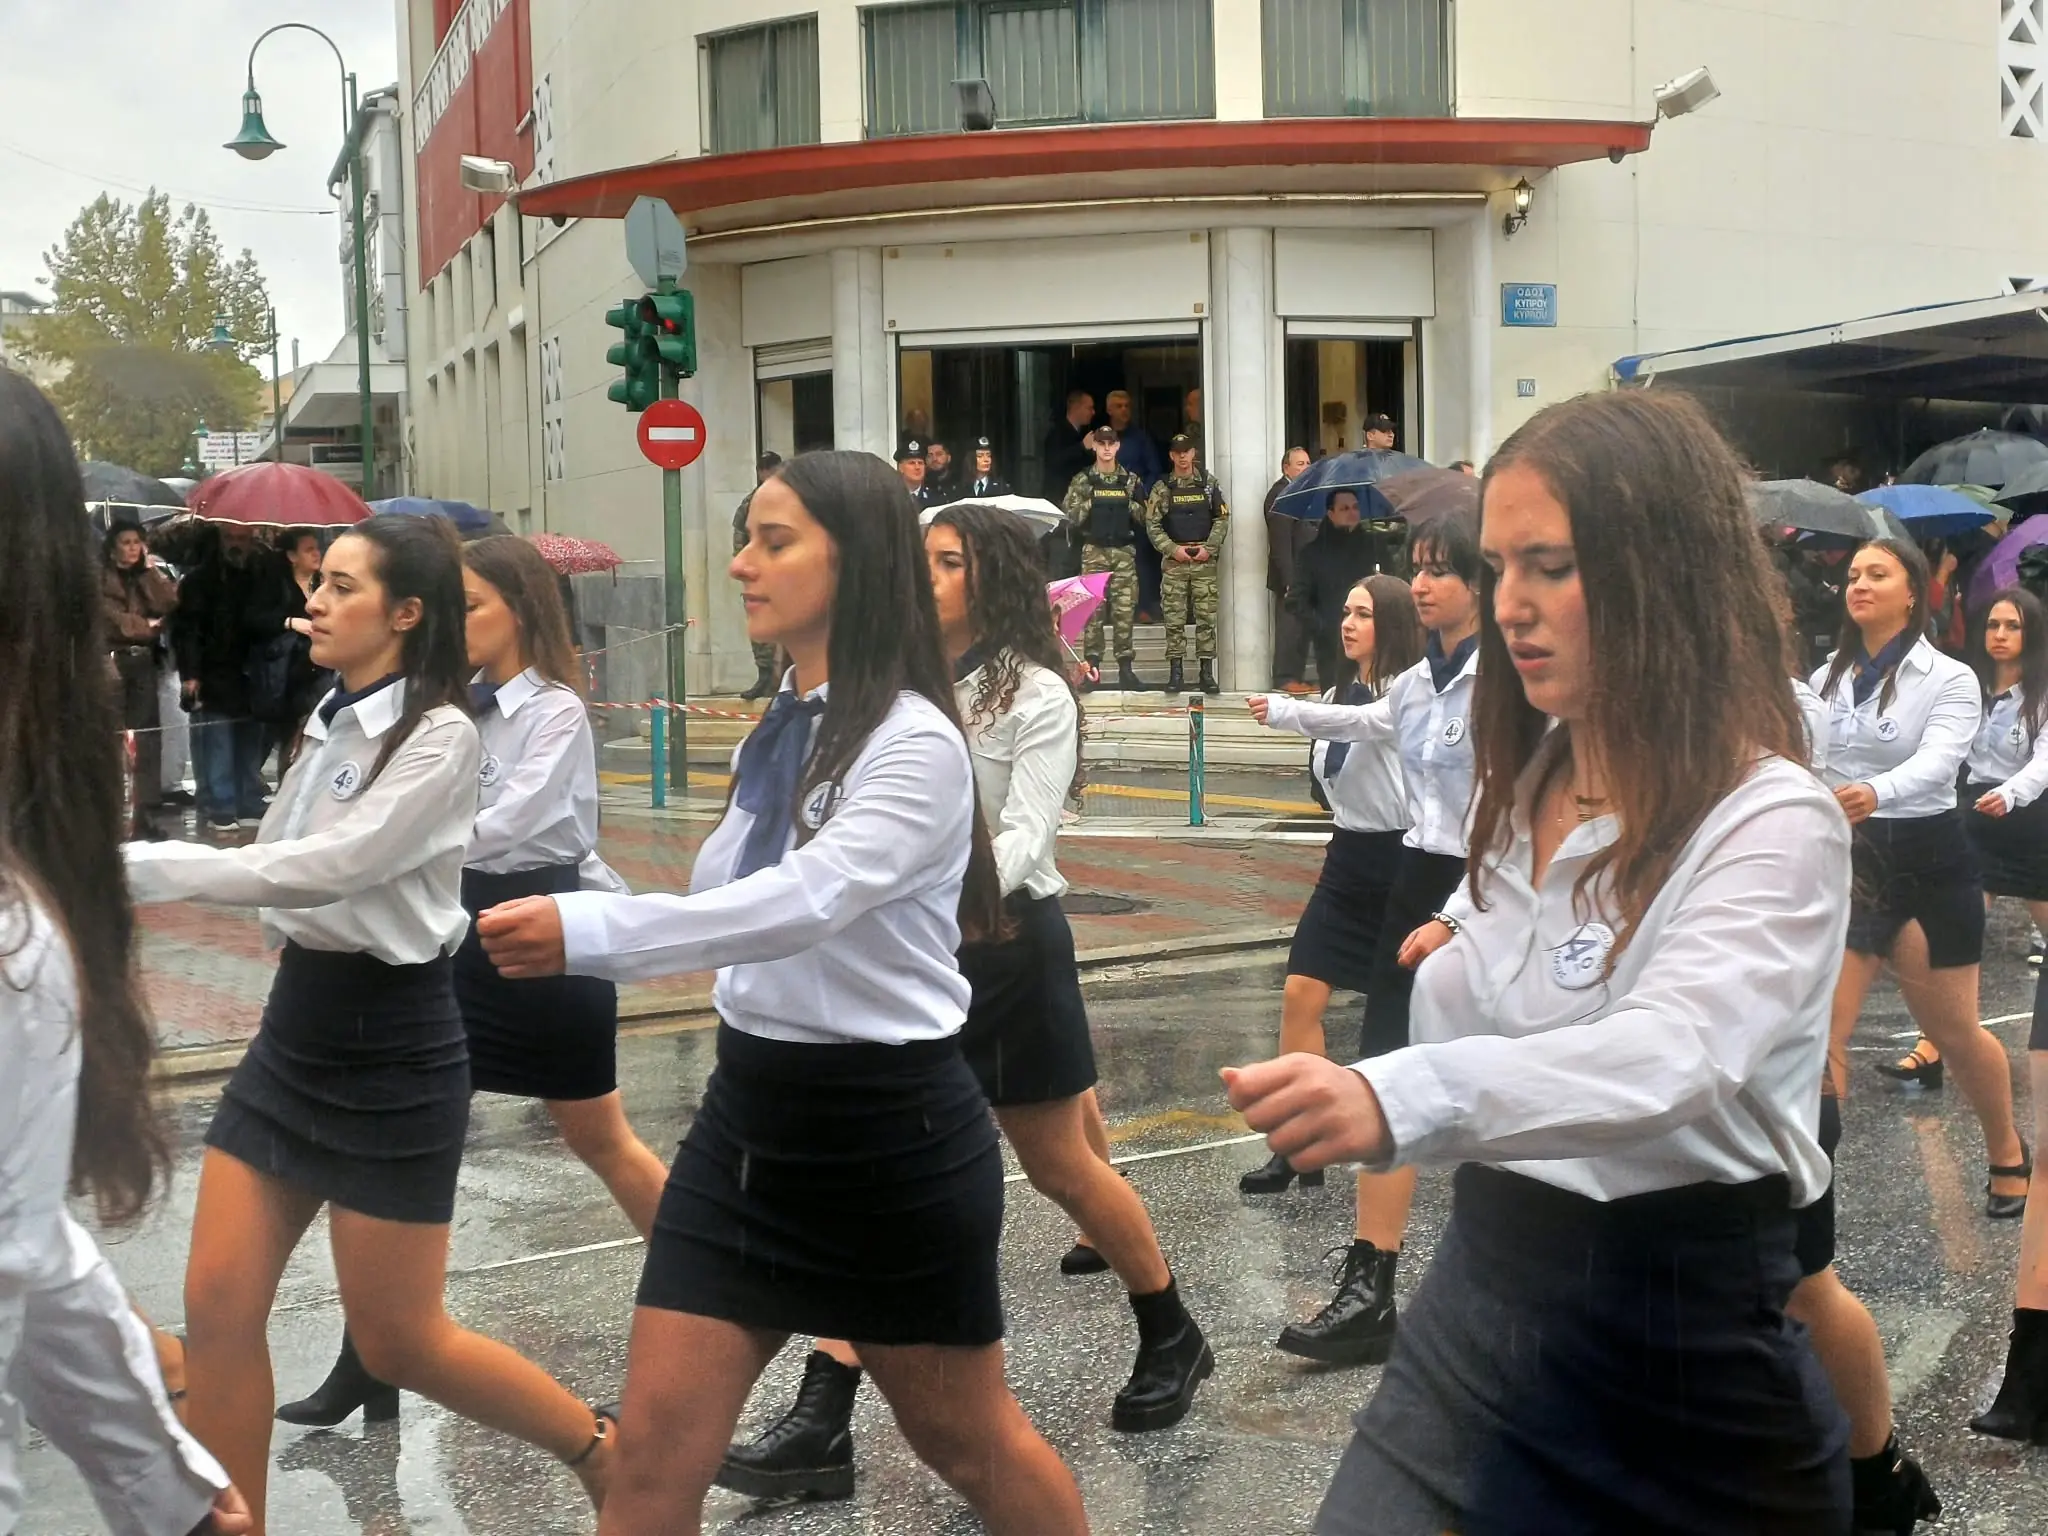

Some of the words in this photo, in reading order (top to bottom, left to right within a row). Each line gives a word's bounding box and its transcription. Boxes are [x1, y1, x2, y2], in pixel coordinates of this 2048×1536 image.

[1517, 287, 1545, 297] ΟΔΟΣ
[1514, 298, 1548, 308] ΚΥΠΡΟΥ
[1521, 381, 1534, 393] 76
